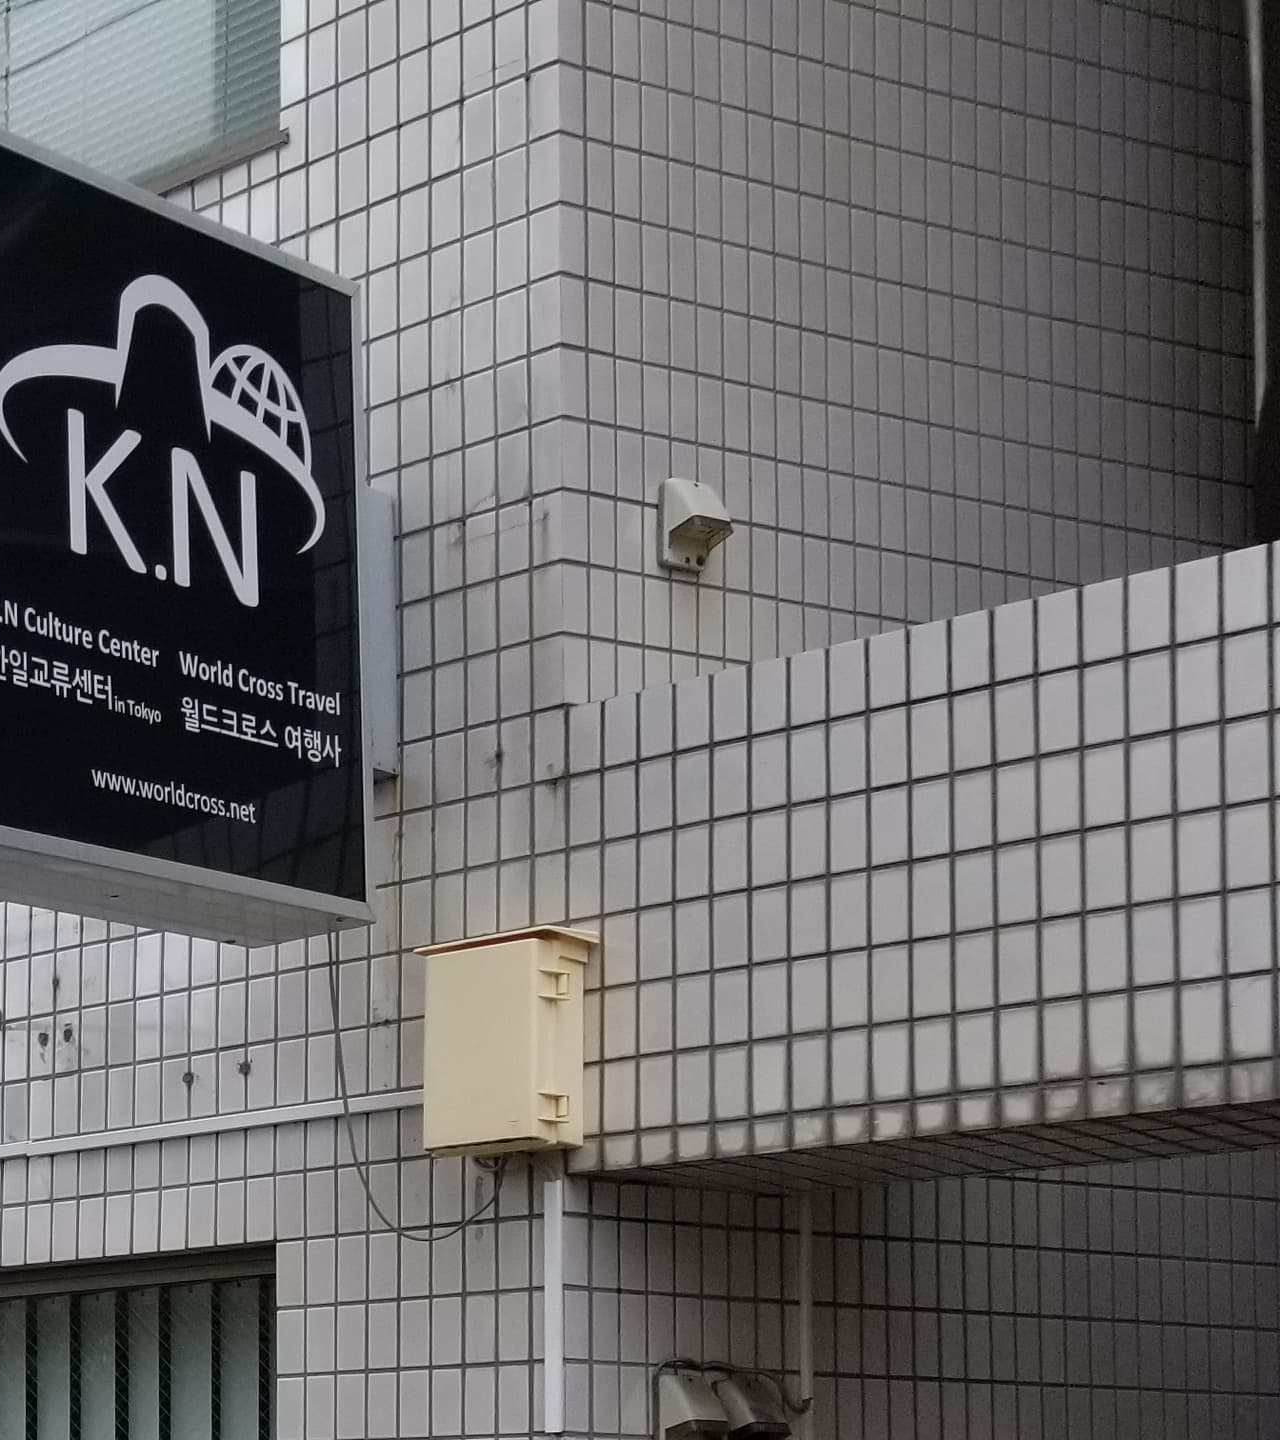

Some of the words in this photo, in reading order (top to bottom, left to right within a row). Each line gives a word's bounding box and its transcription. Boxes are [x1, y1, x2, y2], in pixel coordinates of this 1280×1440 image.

[67, 407, 260, 608] K.N
[24, 607, 93, 649] Culture
[98, 629, 160, 668] Center
[114, 695, 126, 714] in
[127, 699, 162, 726] Tokyo
[179, 650, 234, 689] World
[238, 668, 284, 701] Cross
[287, 681, 341, 716] Travel
[181, 696, 279, 748] 월드크로스
[284, 725, 342, 768] 여행사
[91, 768, 256, 824] www.worldcross.net
